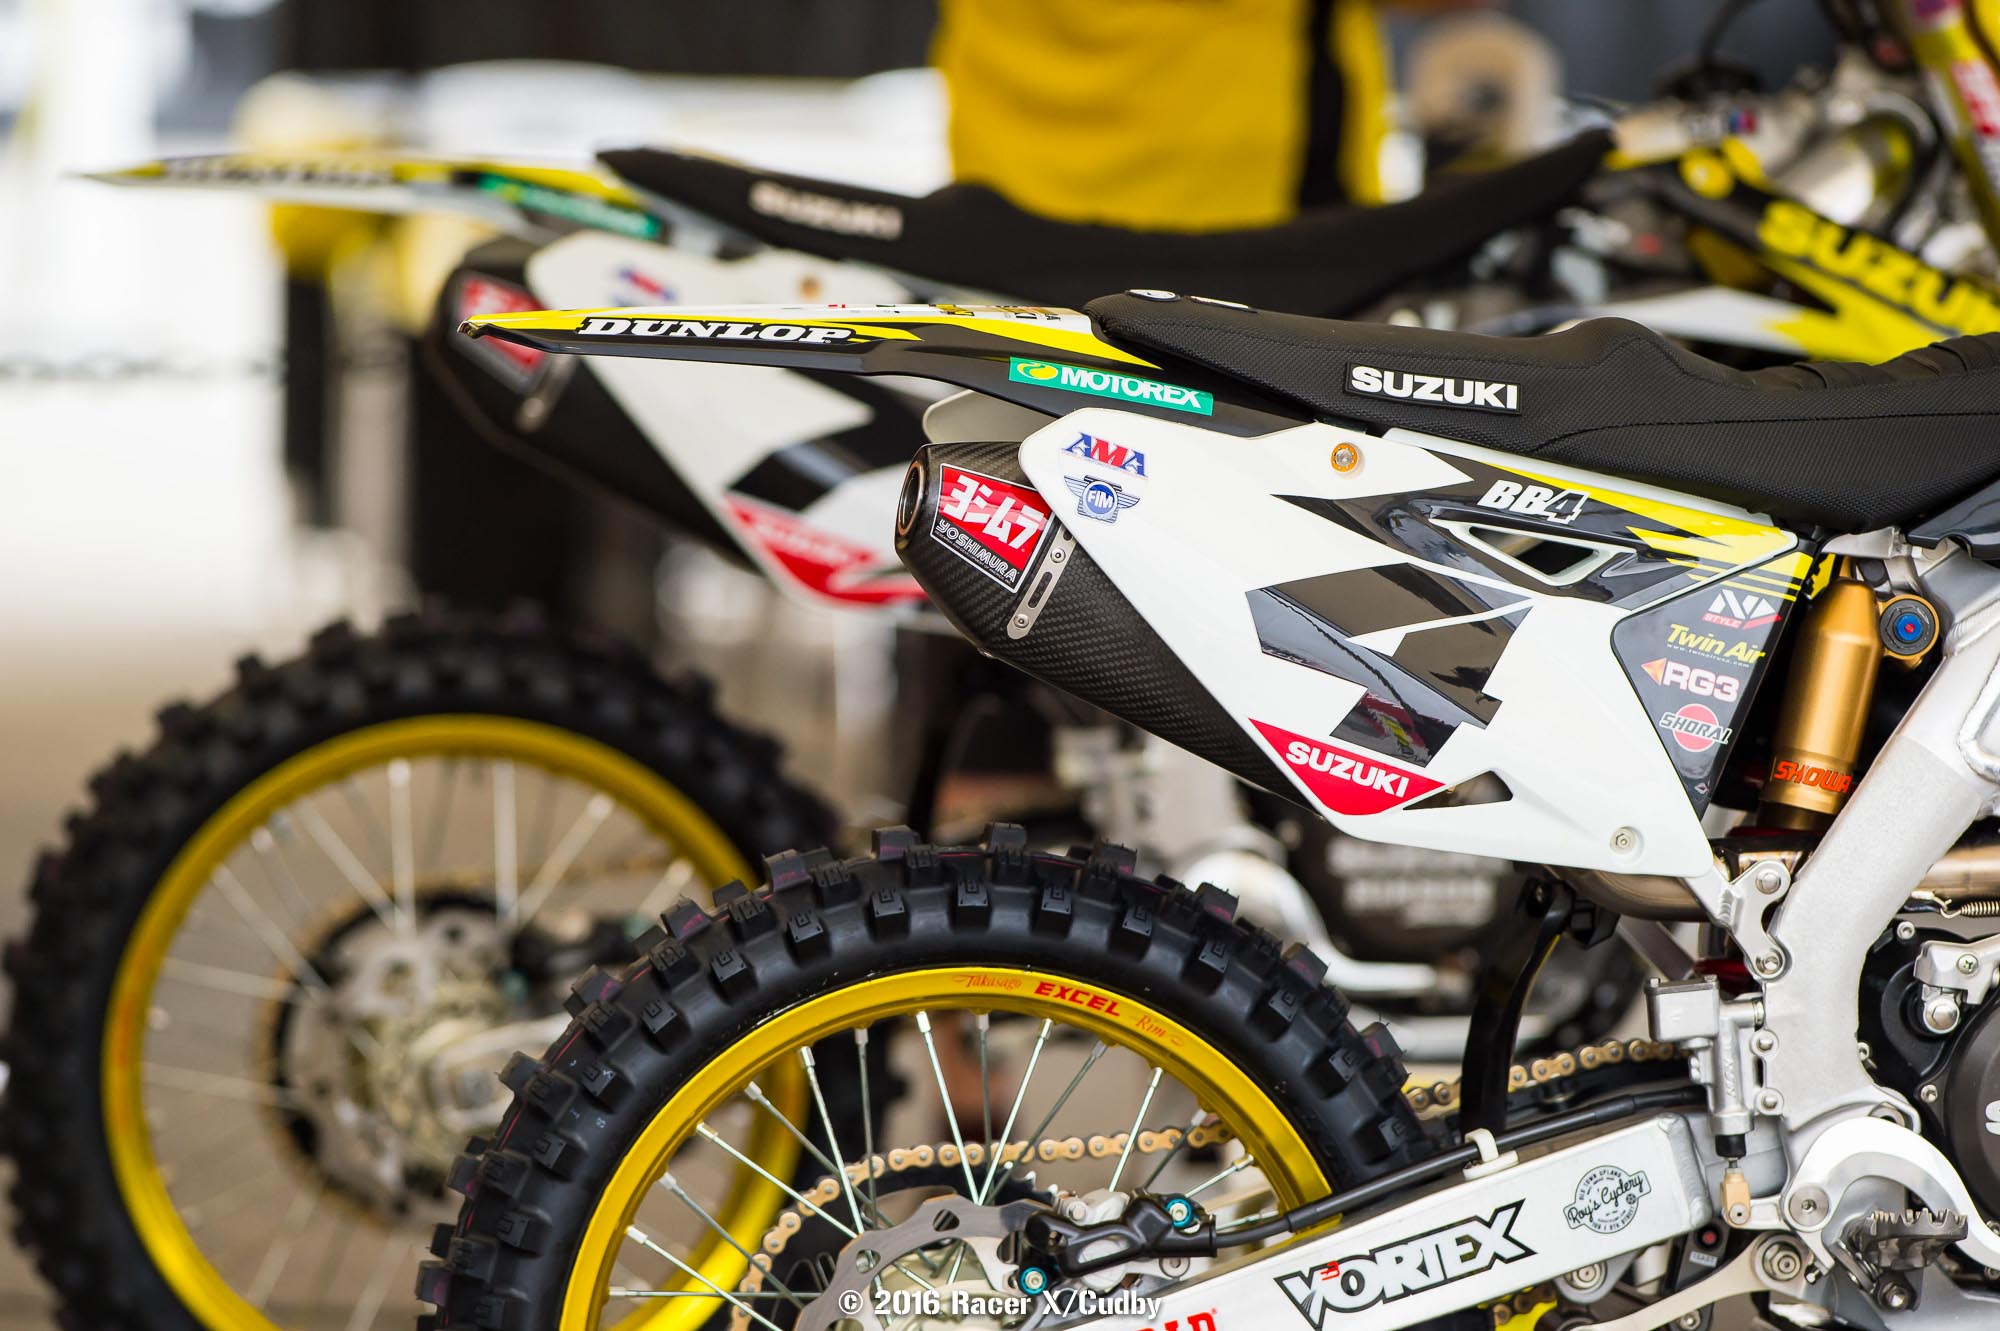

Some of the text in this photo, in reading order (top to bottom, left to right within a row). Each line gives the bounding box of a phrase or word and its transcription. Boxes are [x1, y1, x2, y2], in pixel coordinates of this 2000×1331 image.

[576, 318, 851, 343] DUNLOP
[1060, 366, 1201, 409] MOTOREX
[1351, 366, 1519, 410] SUZUKI
[1062, 432, 1148, 478] AMA
[942, 474, 1044, 550] ヨシムラ
[1087, 490, 1114, 509] FIM
[1476, 479, 1591, 525] BB4
[936, 518, 1018, 584] YOSHIMURA
[1703, 613, 1743, 629] STYLE
[1667, 623, 1766, 664] Twin Air
[1663, 661, 1740, 703] RG3
[1659, 712, 1733, 745] SHORAI
[1285, 740, 1410, 798] SUZUKI
[1034, 981, 1121, 1017] EXCEL
[1568, 1175, 1643, 1224] Roy's Cyclery
[1274, 1200, 1536, 1330] VORTEX
